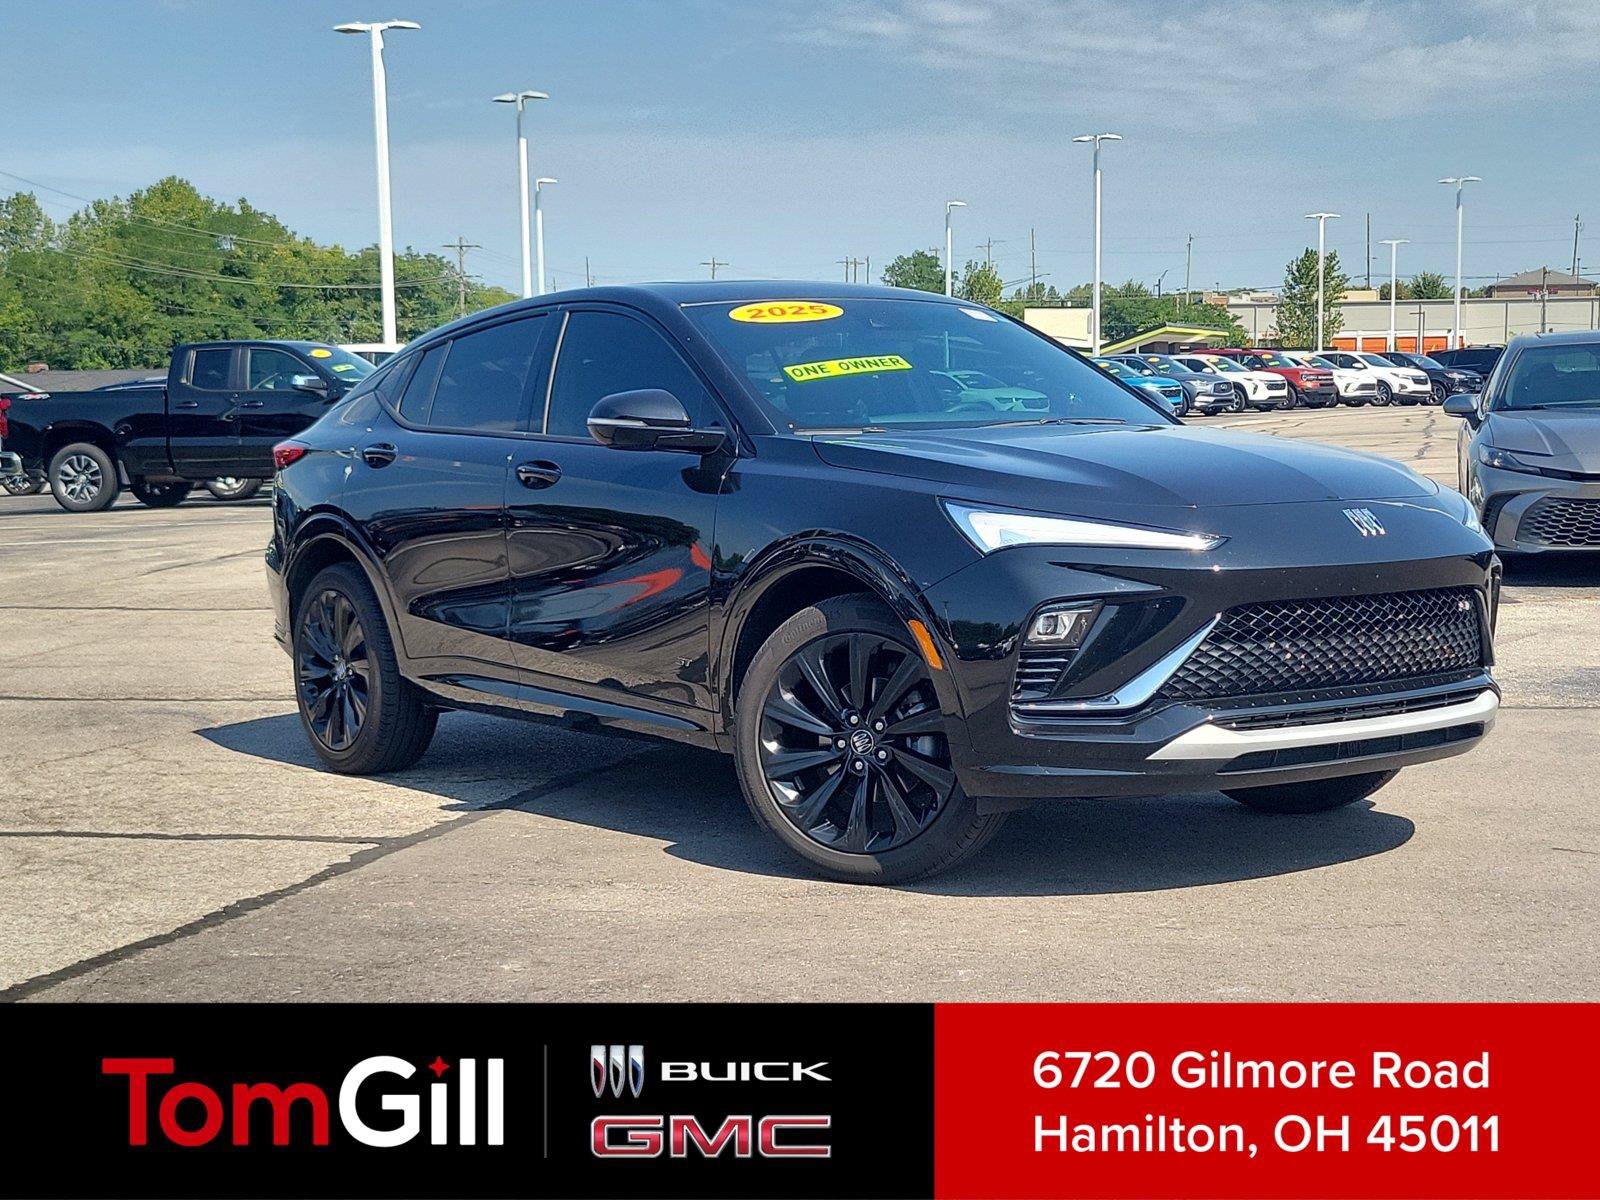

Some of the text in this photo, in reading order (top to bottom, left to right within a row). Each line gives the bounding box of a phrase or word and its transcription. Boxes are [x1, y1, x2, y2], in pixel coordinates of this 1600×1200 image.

[746, 304, 828, 319] 2025
[791, 356, 904, 378] ONE OWNER
